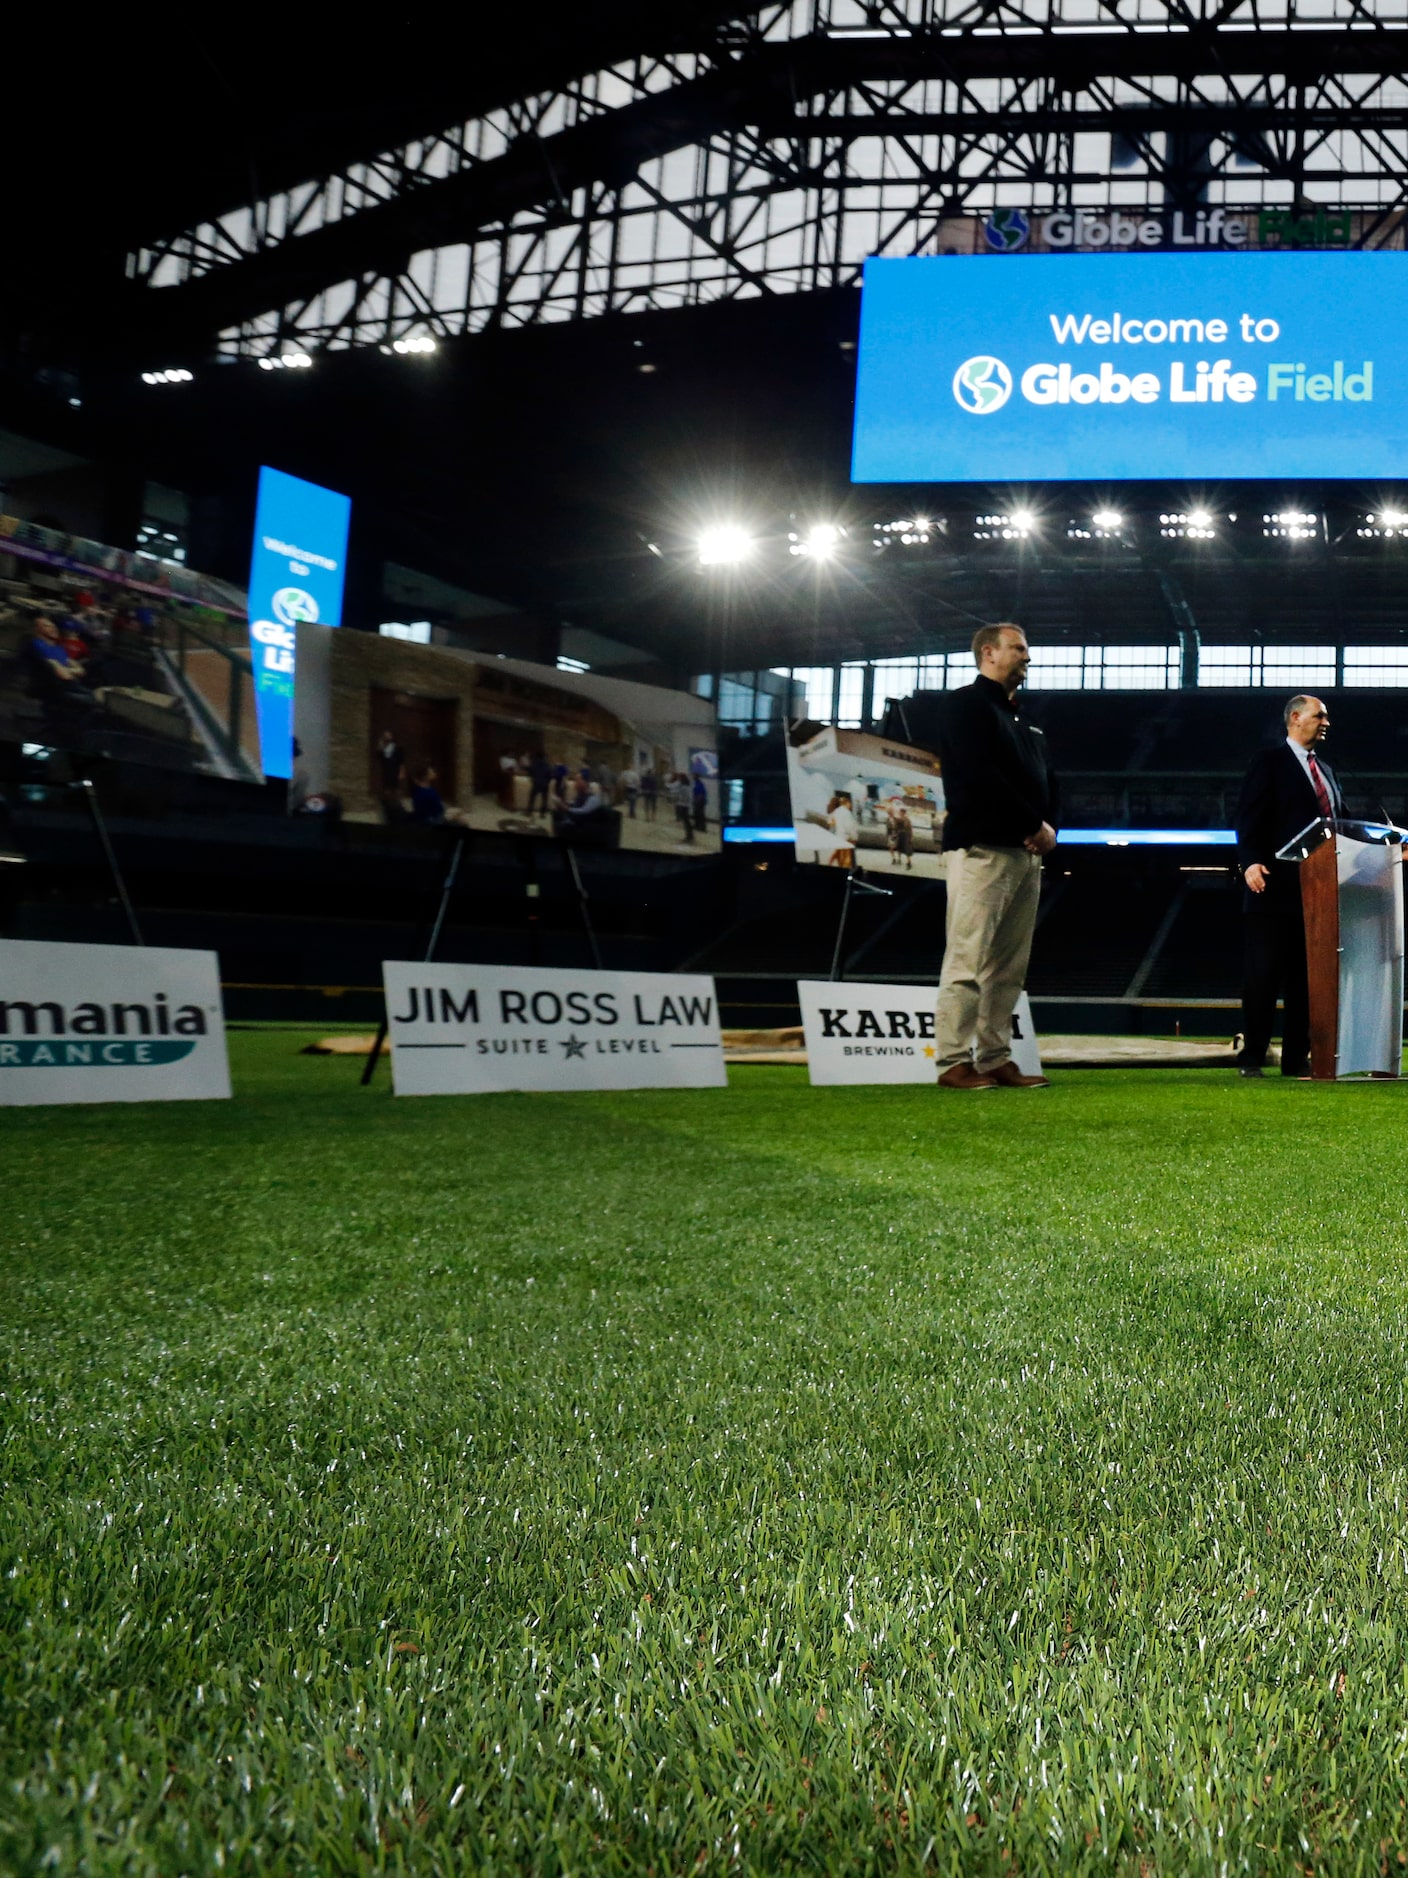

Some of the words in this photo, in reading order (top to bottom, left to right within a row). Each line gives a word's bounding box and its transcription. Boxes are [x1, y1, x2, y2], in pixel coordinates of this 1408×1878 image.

[1043, 210, 1163, 246] Globe
[1172, 210, 1248, 245] Life
[1258, 210, 1351, 244] Field
[1050, 313, 1227, 344] Welcome
[1240, 313, 1280, 343] to
[1021, 363, 1161, 405] Globe
[1169, 359, 1257, 403] Life
[1267, 361, 1374, 401] Field
[263, 536, 338, 570] Welcome
[289, 560, 310, 577] to
[0, 992, 207, 1035] mania
[394, 987, 479, 1024] JIM
[500, 990, 619, 1026] ROSS
[634, 994, 712, 1026] LAW
[0, 1043, 153, 1064] RANCE
[477, 1039, 548, 1055] SUITE
[596, 1039, 661, 1054] LEVEL
[843, 1046, 915, 1057] BREWING
